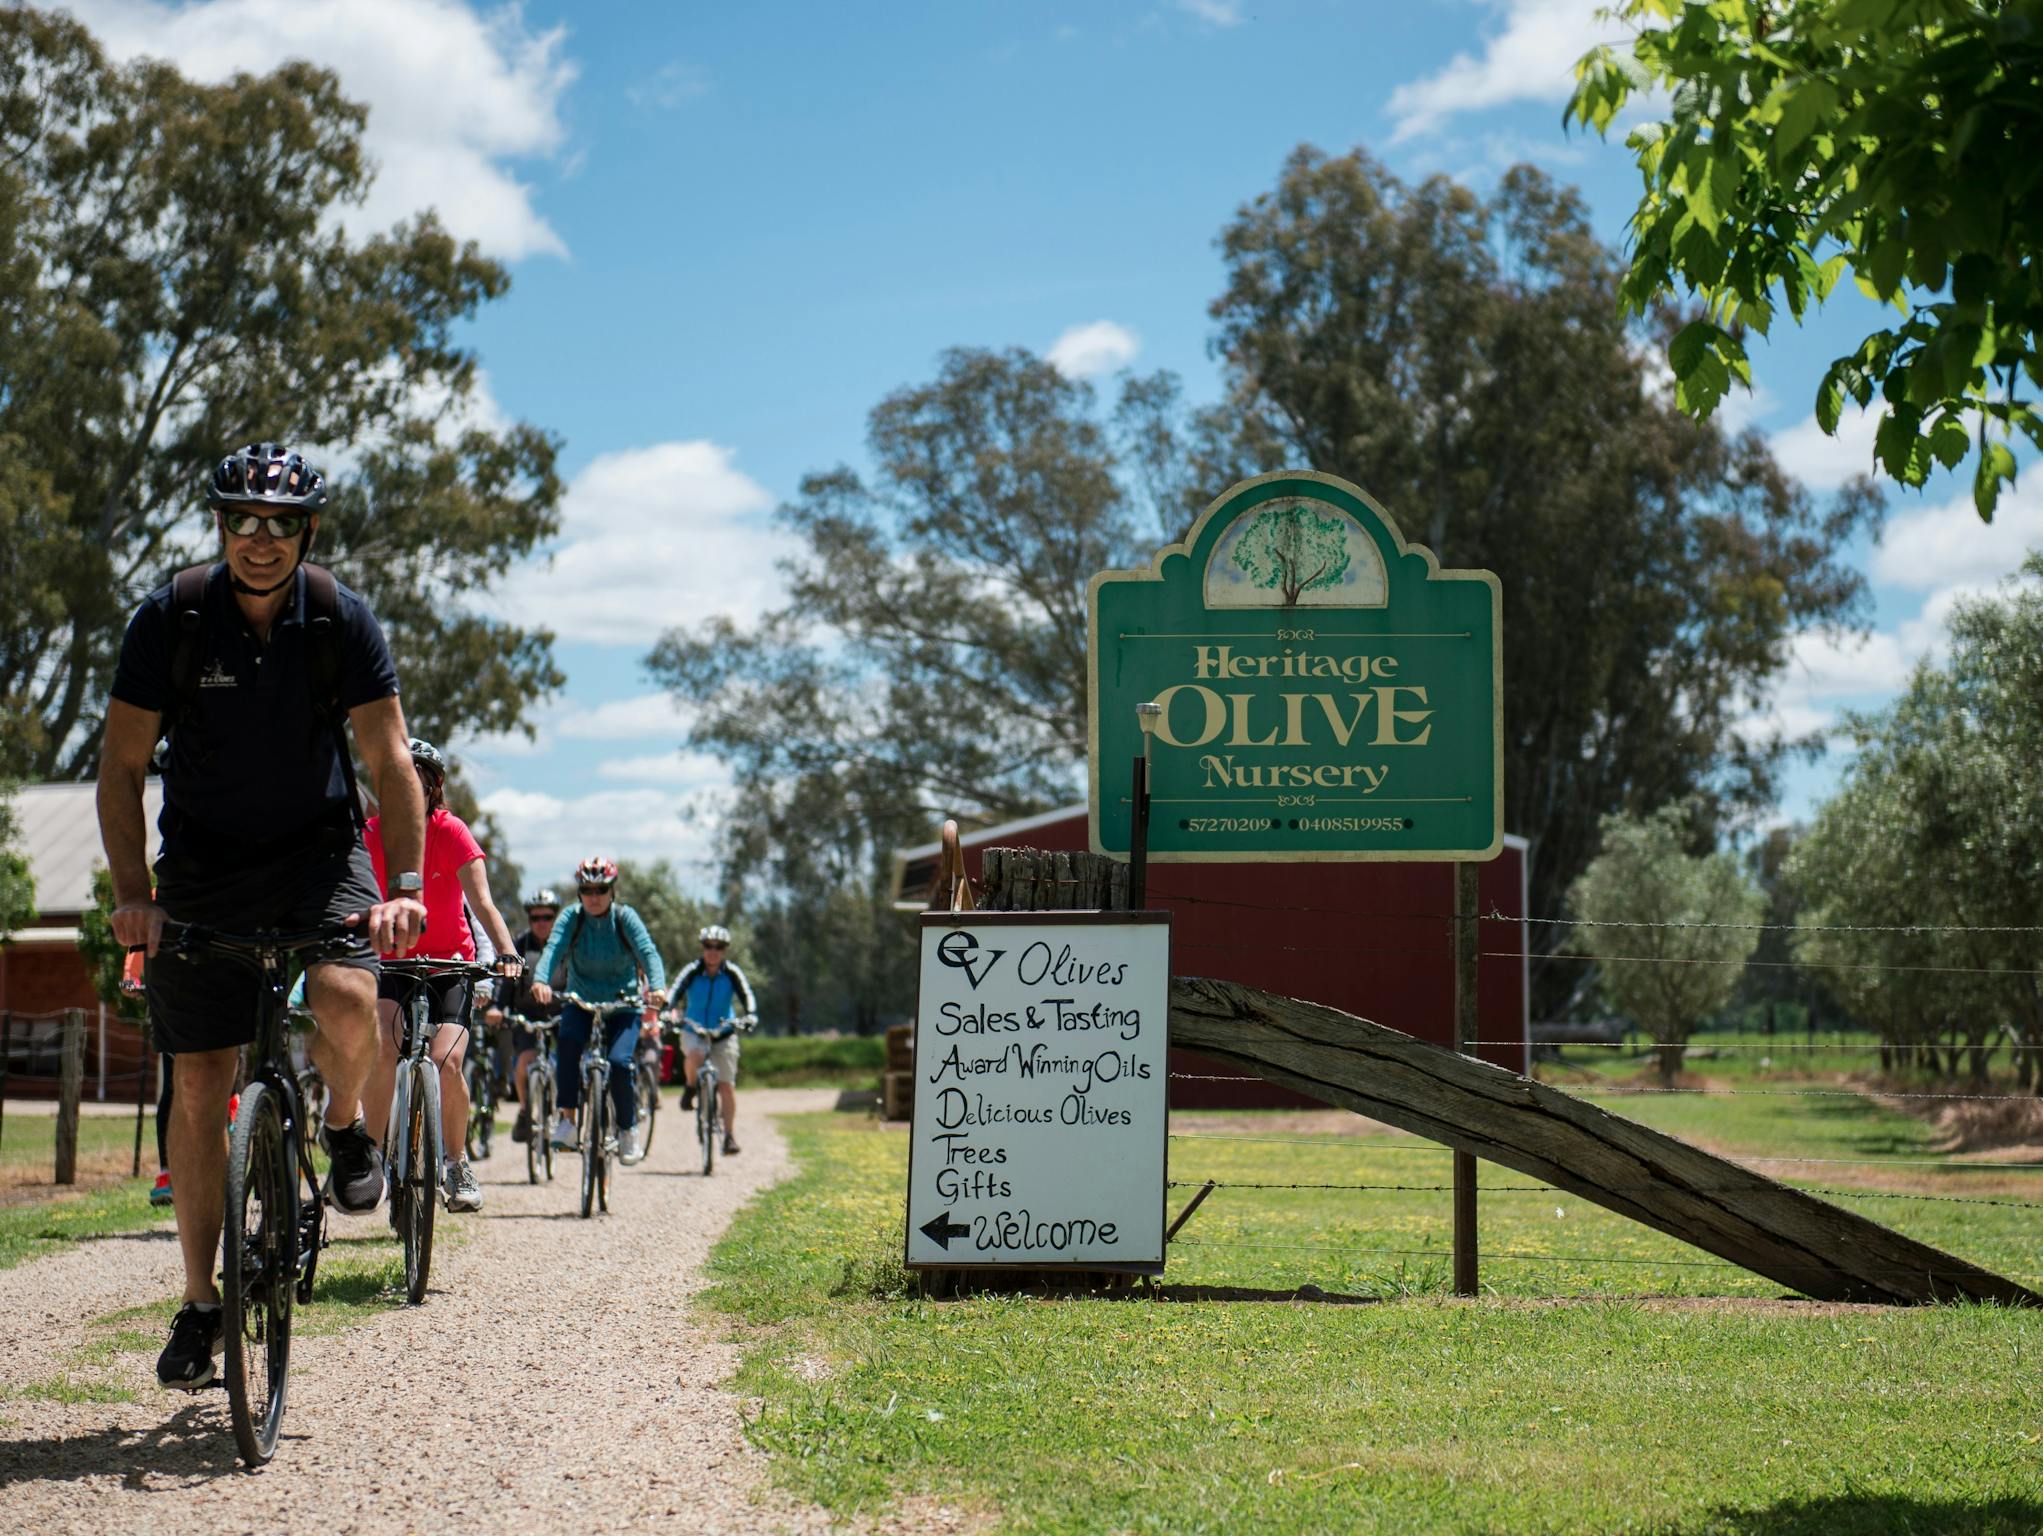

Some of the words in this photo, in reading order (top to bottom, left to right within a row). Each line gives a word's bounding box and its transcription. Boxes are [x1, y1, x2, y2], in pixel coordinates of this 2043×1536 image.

[1193, 645, 1399, 684] Heritage
[1149, 684, 1438, 748] OLIVE
[1199, 754, 1389, 794] Nursery
[1188, 817, 1272, 832] 57270209
[1299, 817, 1403, 832] 0408519955
[1018, 941, 1129, 986] Olives
[936, 1002, 1021, 1036] Sales
[1026, 1006, 1046, 1029] &
[1041, 999, 1141, 1041] Tasting
[930, 1044, 1009, 1084] Award
[1011, 1043, 1095, 1094] Winning
[1094, 1050, 1151, 1083] Oils
[936, 1087, 1053, 1130] Delicious
[1060, 1094, 1132, 1126] Olives
[932, 1133, 1007, 1165] Trees
[936, 1168, 1012, 1206] Gifts
[974, 1209, 1119, 1251] Welcome
